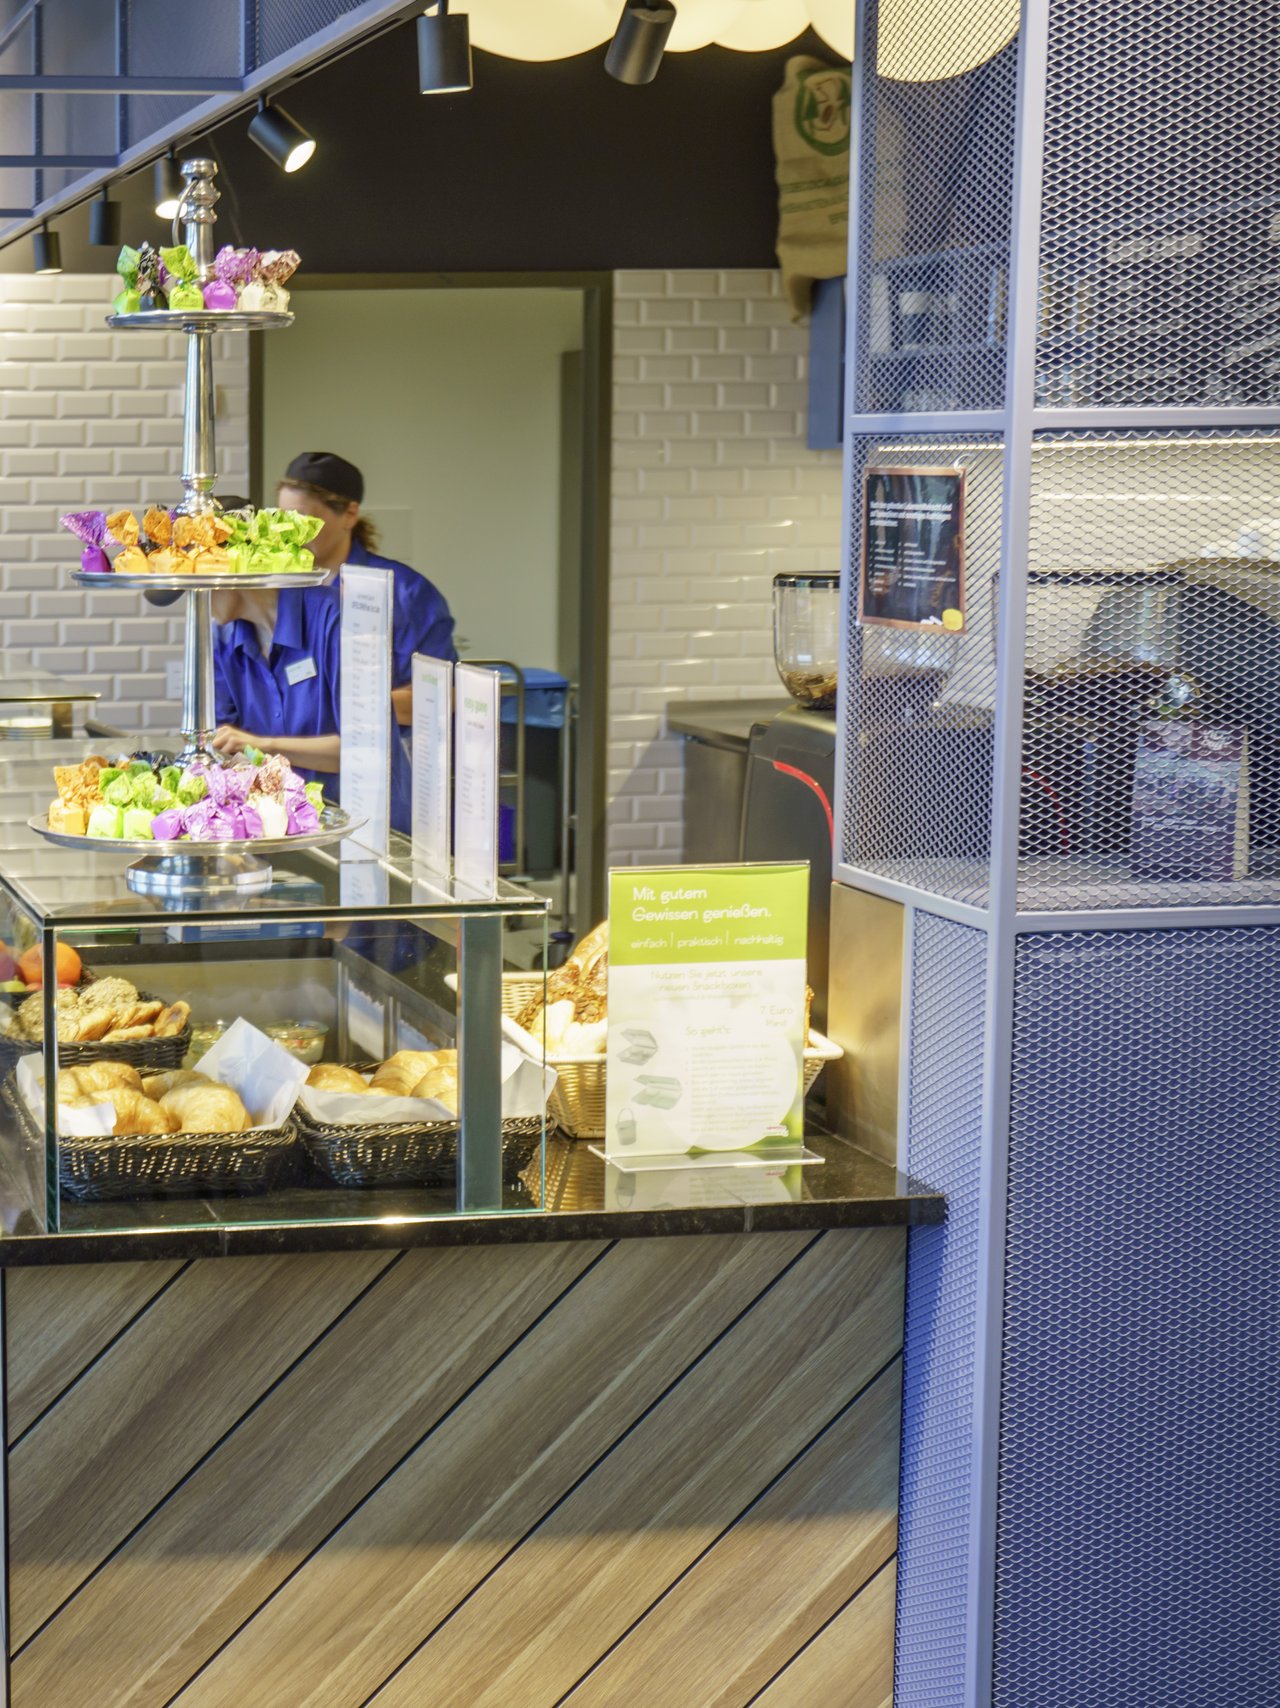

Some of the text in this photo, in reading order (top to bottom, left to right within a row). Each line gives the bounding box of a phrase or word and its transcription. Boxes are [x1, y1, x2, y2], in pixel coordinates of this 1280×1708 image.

[632, 886, 708, 904] Mit gutem
[631, 903, 773, 923] Gewissen genießen.
[630, 934, 785, 949] einfach praktisch nachhaltig
[651, 971, 685, 980] Nutzen
[688, 969, 702, 979] Sie
[732, 968, 763, 977] unsere
[658, 983, 688, 992] neuen
[760, 1004, 794, 1016] 7 Euro
[686, 1026, 700, 1036] So
